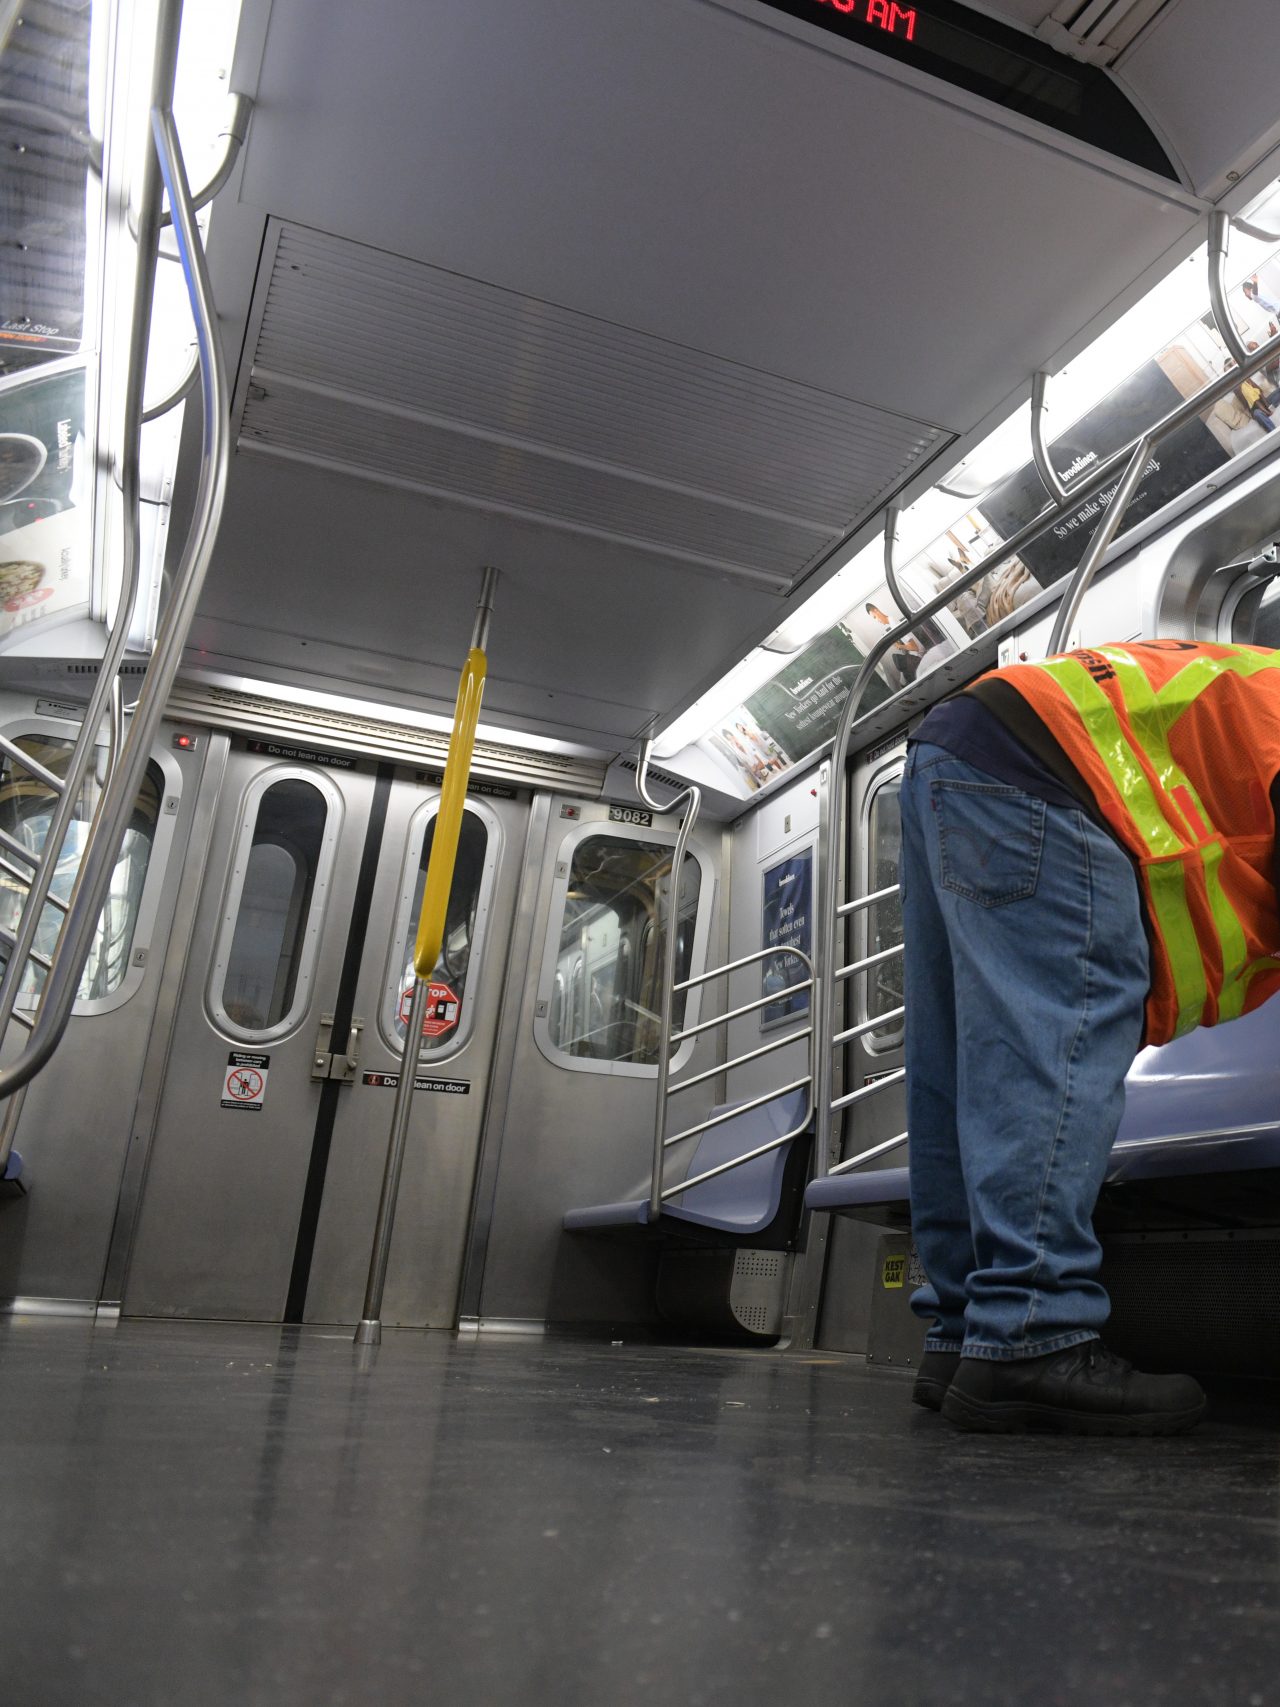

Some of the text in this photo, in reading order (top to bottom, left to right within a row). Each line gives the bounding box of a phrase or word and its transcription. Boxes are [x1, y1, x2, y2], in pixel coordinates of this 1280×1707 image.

[866, 0, 917, 41] AM
[1053, 525, 1069, 539] So
[1065, 516, 1080, 530] we
[1077, 501, 1101, 522] make
[268, 745, 351, 767] Do not lean on door
[613, 808, 650, 825] 9082
[428, 988, 447, 998] OP
[383, 1077, 397, 1086] Do
[414, 1080, 432, 1090] lean
[445, 1083, 466, 1092] door
